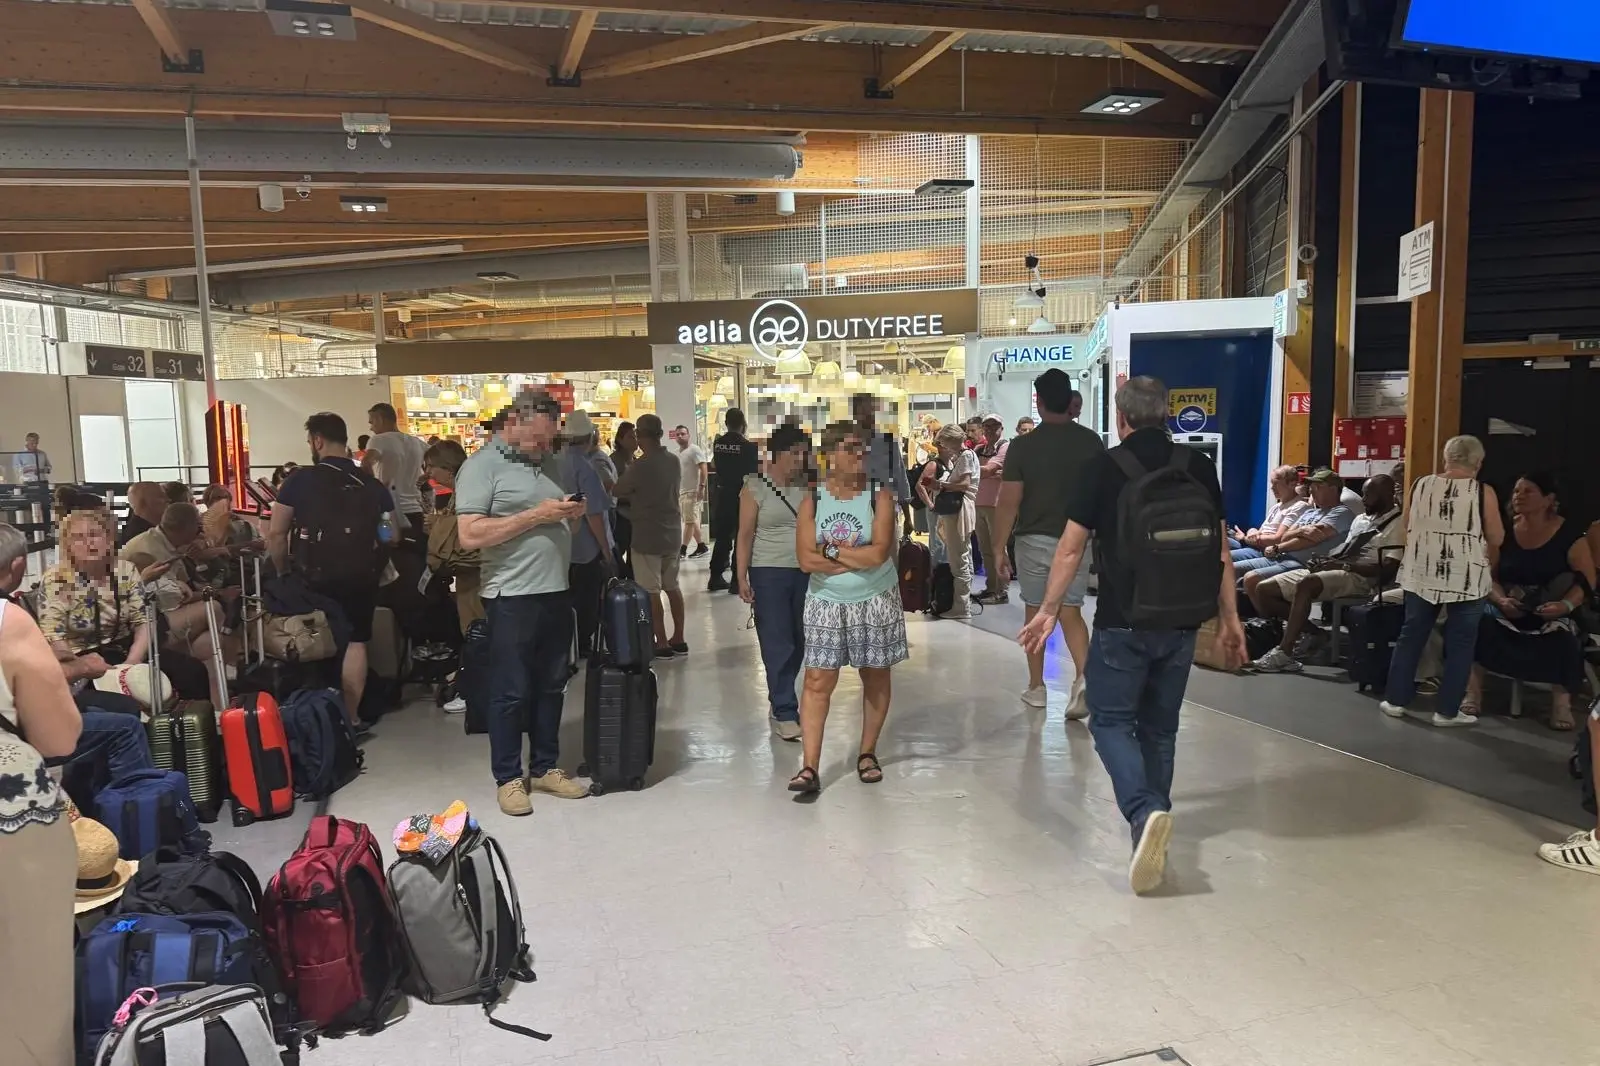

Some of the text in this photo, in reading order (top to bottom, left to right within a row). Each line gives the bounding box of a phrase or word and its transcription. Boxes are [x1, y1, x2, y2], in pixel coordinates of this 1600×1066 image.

[1412, 229, 1431, 251] ATM
[678, 319, 742, 344] aelia
[127, 355, 145, 372] 32
[168, 358, 183, 374] 31
[1177, 393, 1208, 403] ATM
[715, 443, 741, 451] POLICE
[820, 511, 864, 532] CALIFORNIA
